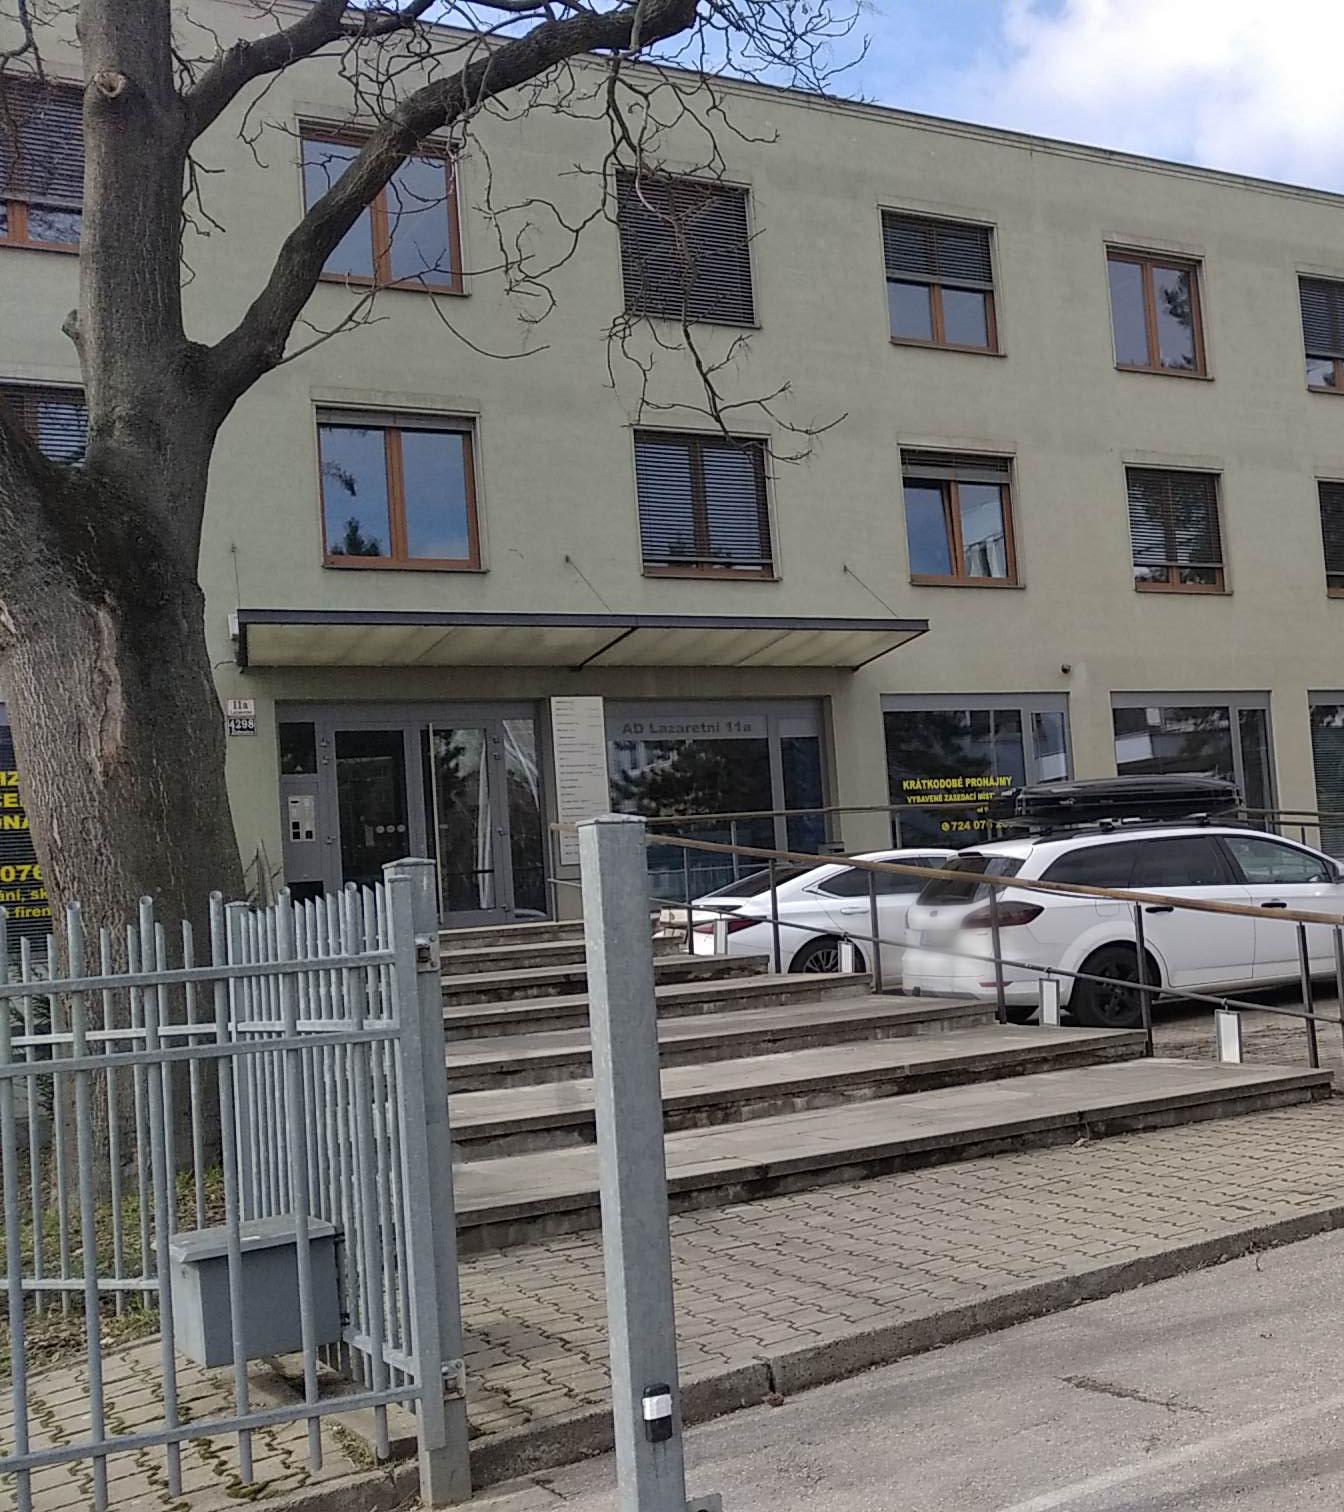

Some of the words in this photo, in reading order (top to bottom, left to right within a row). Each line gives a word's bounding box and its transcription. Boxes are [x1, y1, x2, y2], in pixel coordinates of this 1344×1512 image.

[233, 700, 249, 710] 11a
[228, 718, 254, 730] 4298
[622, 723, 644, 735] AD
[726, 721, 752, 732] 11a
[902, 776, 963, 790] KRÁTKODOBÉ
[965, 776, 1012, 788] PRONÁJMY
[943, 791, 977, 802] ZASEDACÍ
[951, 820, 971, 831] 724
